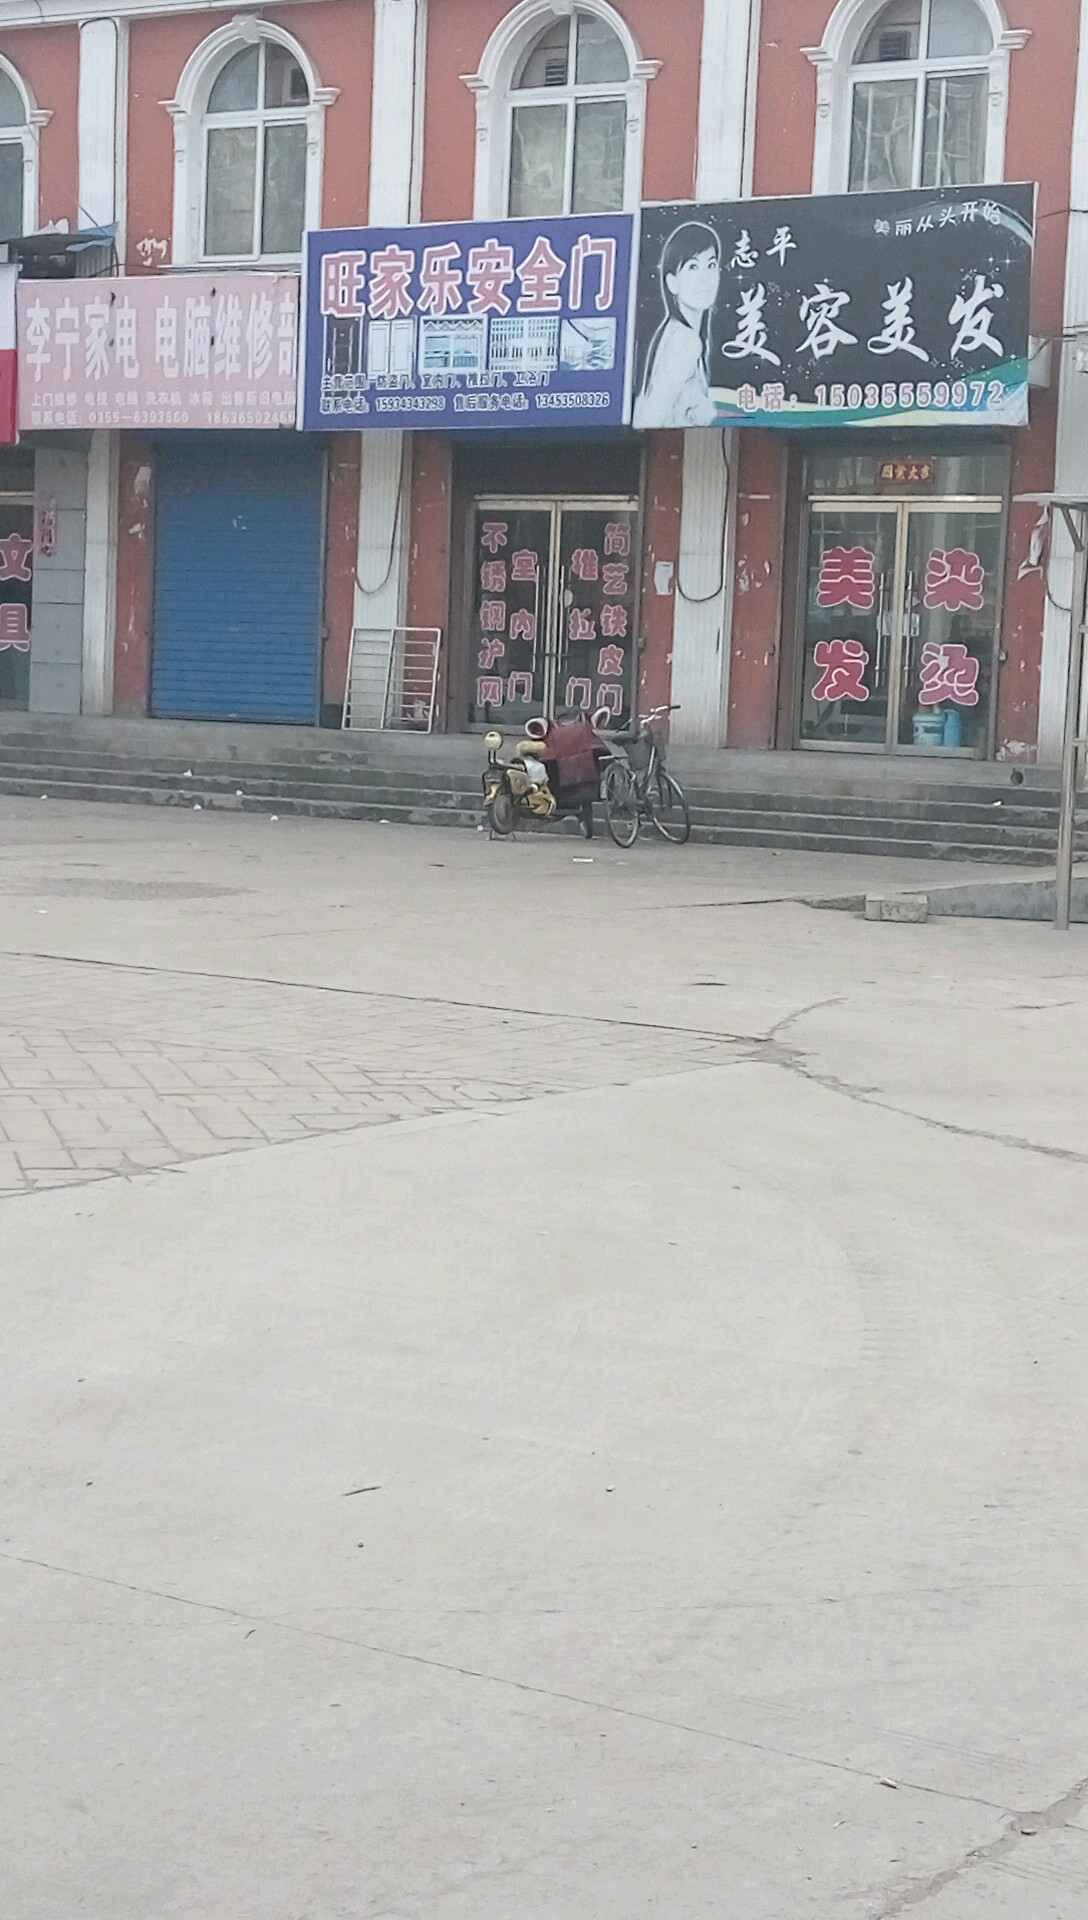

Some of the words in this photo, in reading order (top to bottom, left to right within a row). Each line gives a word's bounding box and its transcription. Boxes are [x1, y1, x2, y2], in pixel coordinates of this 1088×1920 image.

[730, 226, 797, 269] 志平
[872, 201, 1002, 237] 美丽从头开始
[321, 234, 616, 318] 旺家乐安全门
[26, 296, 140, 382] 李宁家电
[722, 275, 1005, 366] 美容美发
[535, 391, 610, 409] 13453508326
[814, 381, 1004, 408] 15035559972
[0, 533, 33, 652] 文具
[507, 549, 538, 704] 室内门
[565, 549, 599, 710] 推拉门
[812, 546, 875, 702] 美发
[919, 548, 985, 706] 染烫
